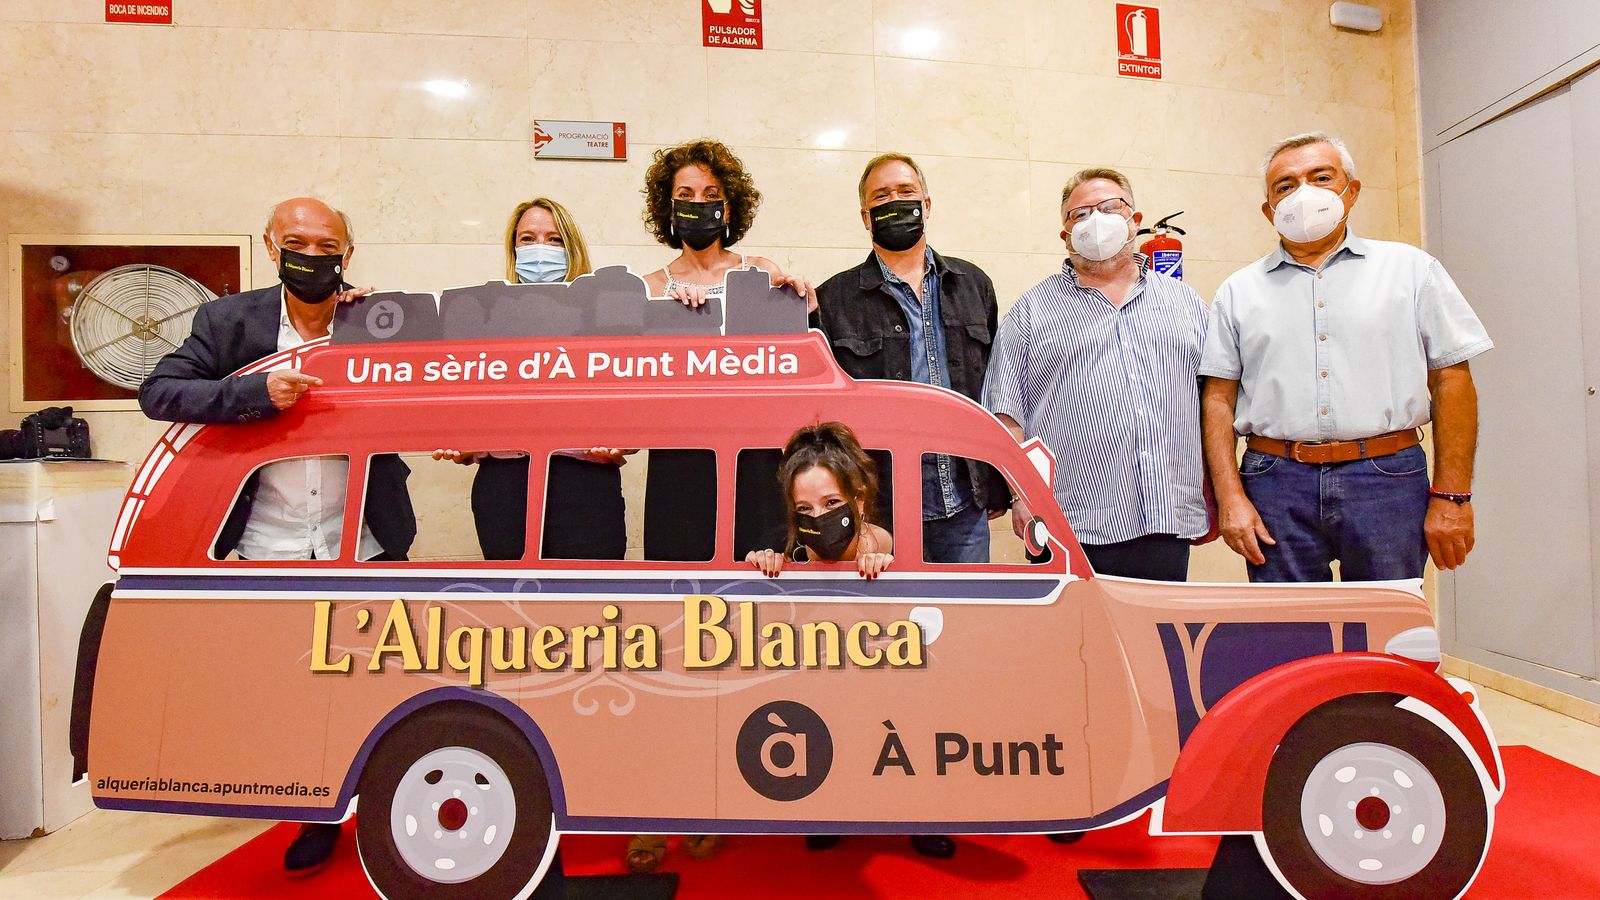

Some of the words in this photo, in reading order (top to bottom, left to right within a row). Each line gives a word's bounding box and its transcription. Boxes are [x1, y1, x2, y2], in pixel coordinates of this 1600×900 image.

[109, 4, 127, 14] BOCA
[127, 5, 136, 15] DE
[137, 5, 169, 16] INCENDIOS
[709, 25, 756, 36] PULSADOR
[708, 35, 721, 44] DE
[721, 36, 758, 46] ALARMA
[1119, 63, 1161, 75] EXTINTOR
[558, 132, 609, 141] PROGRAMACIÓ
[346, 357, 414, 384] Una
[423, 353, 508, 382] sèrie
[587, 351, 675, 378] Punt
[686, 345, 799, 376] Mèdia
[682, 595, 926, 670] Blanca
[759, 711, 807, 778] à
[872, 719, 916, 776] À
[935, 732, 1065, 776] Punt
[97, 776, 331, 797] alqueriablanca.apuntmedia.es
